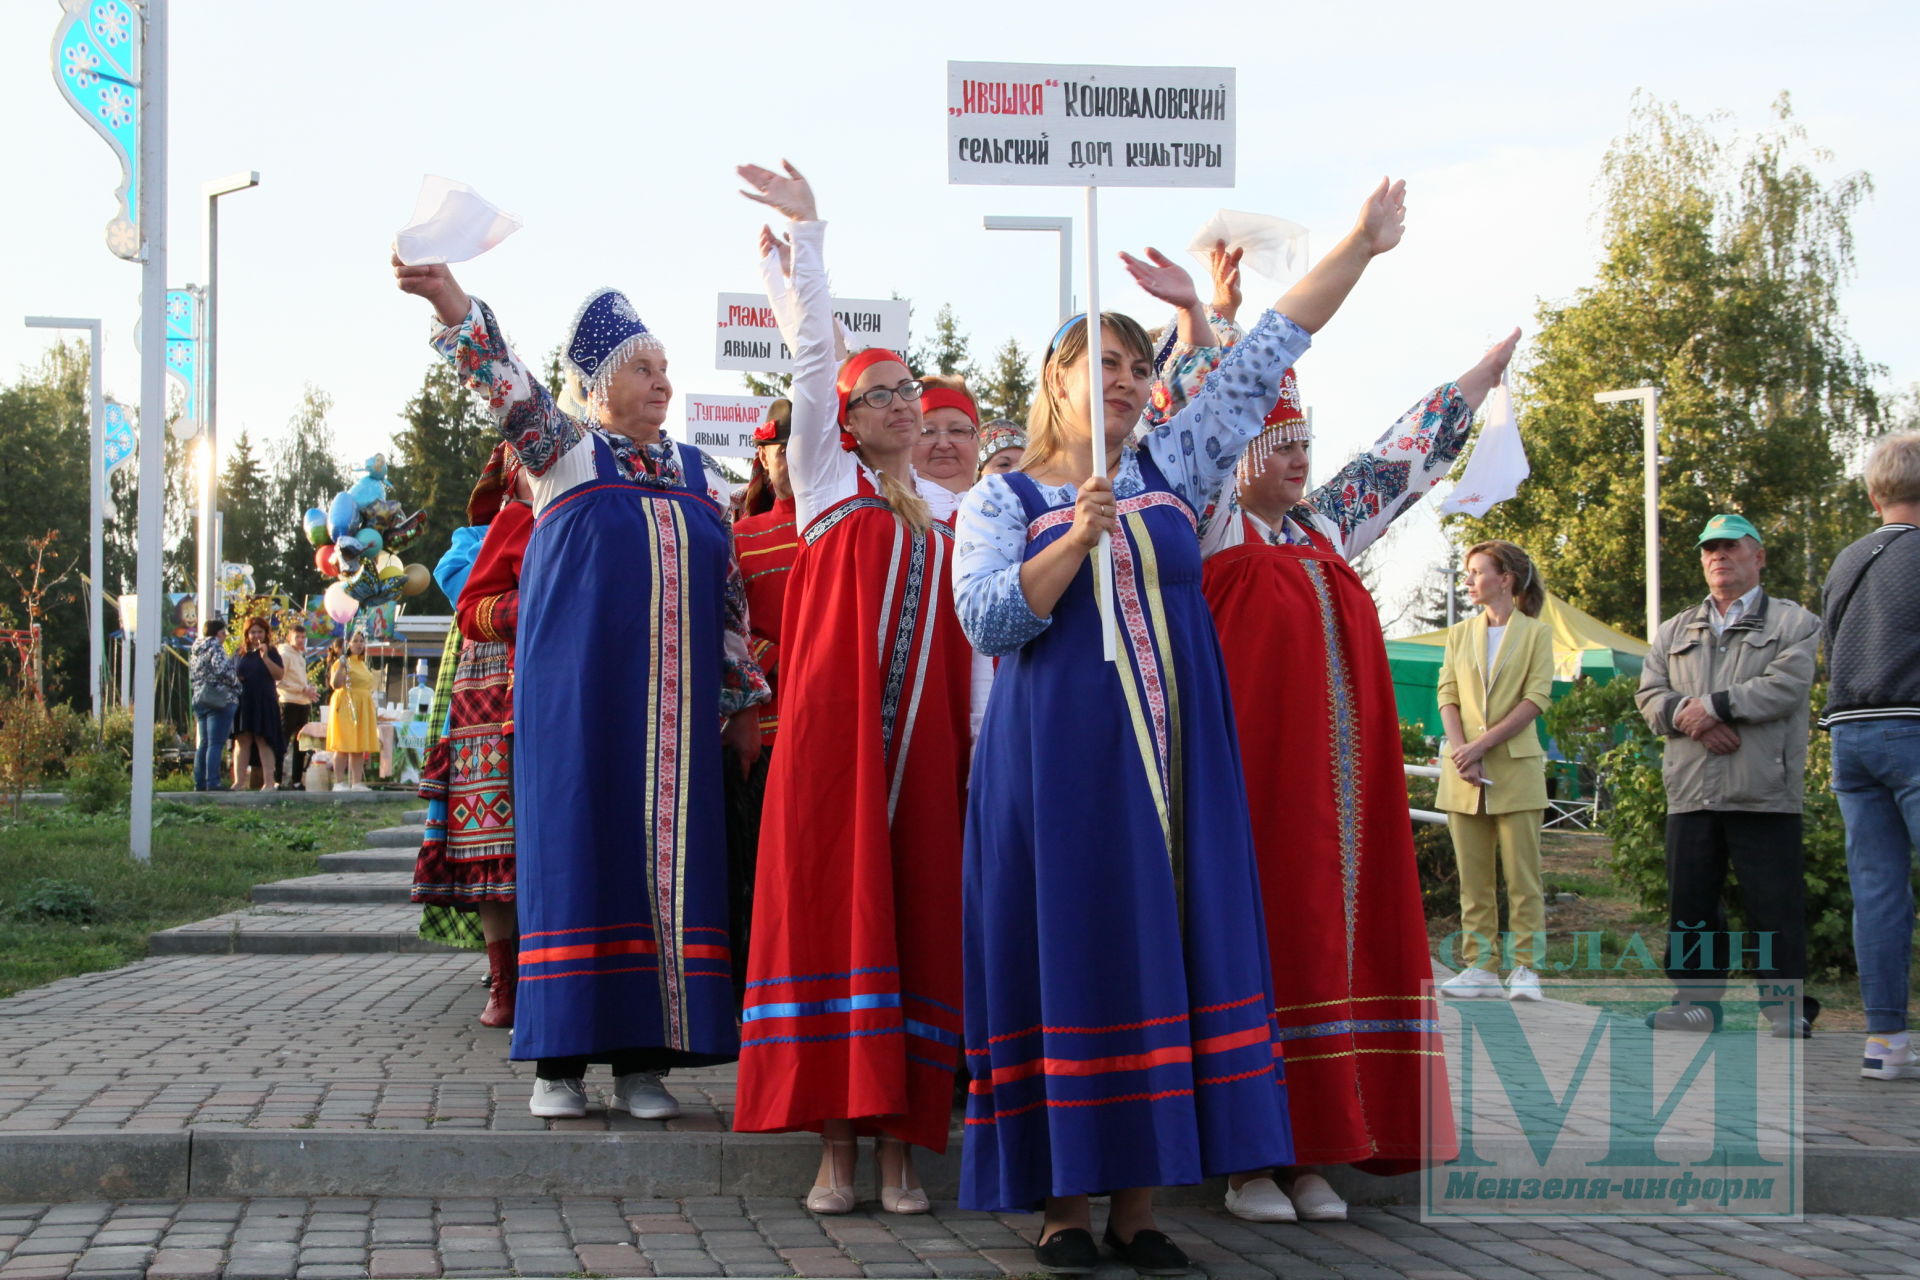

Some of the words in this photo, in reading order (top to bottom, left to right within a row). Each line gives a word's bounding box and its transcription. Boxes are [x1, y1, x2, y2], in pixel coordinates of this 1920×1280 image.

[1064, 82, 1226, 120] КОНОВАЛОВСКИЙ
[1068, 141, 1113, 168] ДОМ
[1126, 143, 1222, 167] КУЛЬТУРЫ
